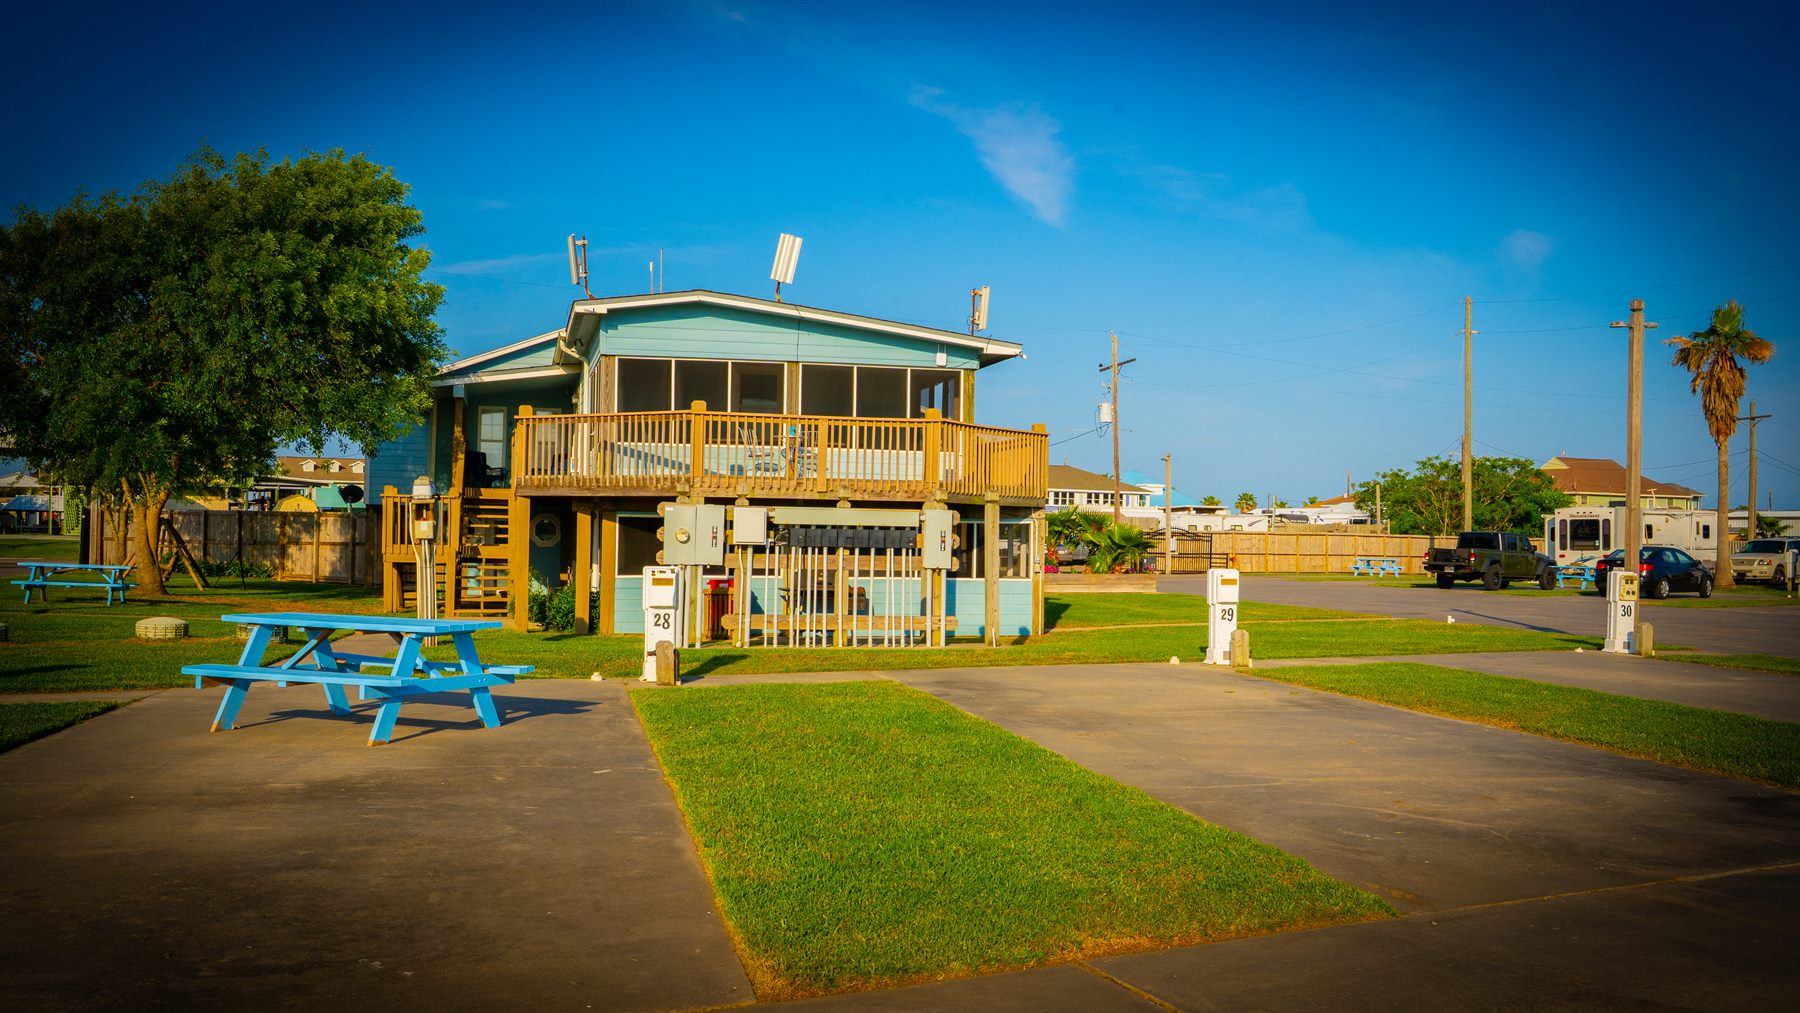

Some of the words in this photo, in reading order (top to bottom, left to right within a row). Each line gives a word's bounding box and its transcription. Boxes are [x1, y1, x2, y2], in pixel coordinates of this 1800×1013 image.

[1221, 607, 1234, 622] 29
[1620, 604, 1632, 617] 30
[653, 612, 671, 630] 28
